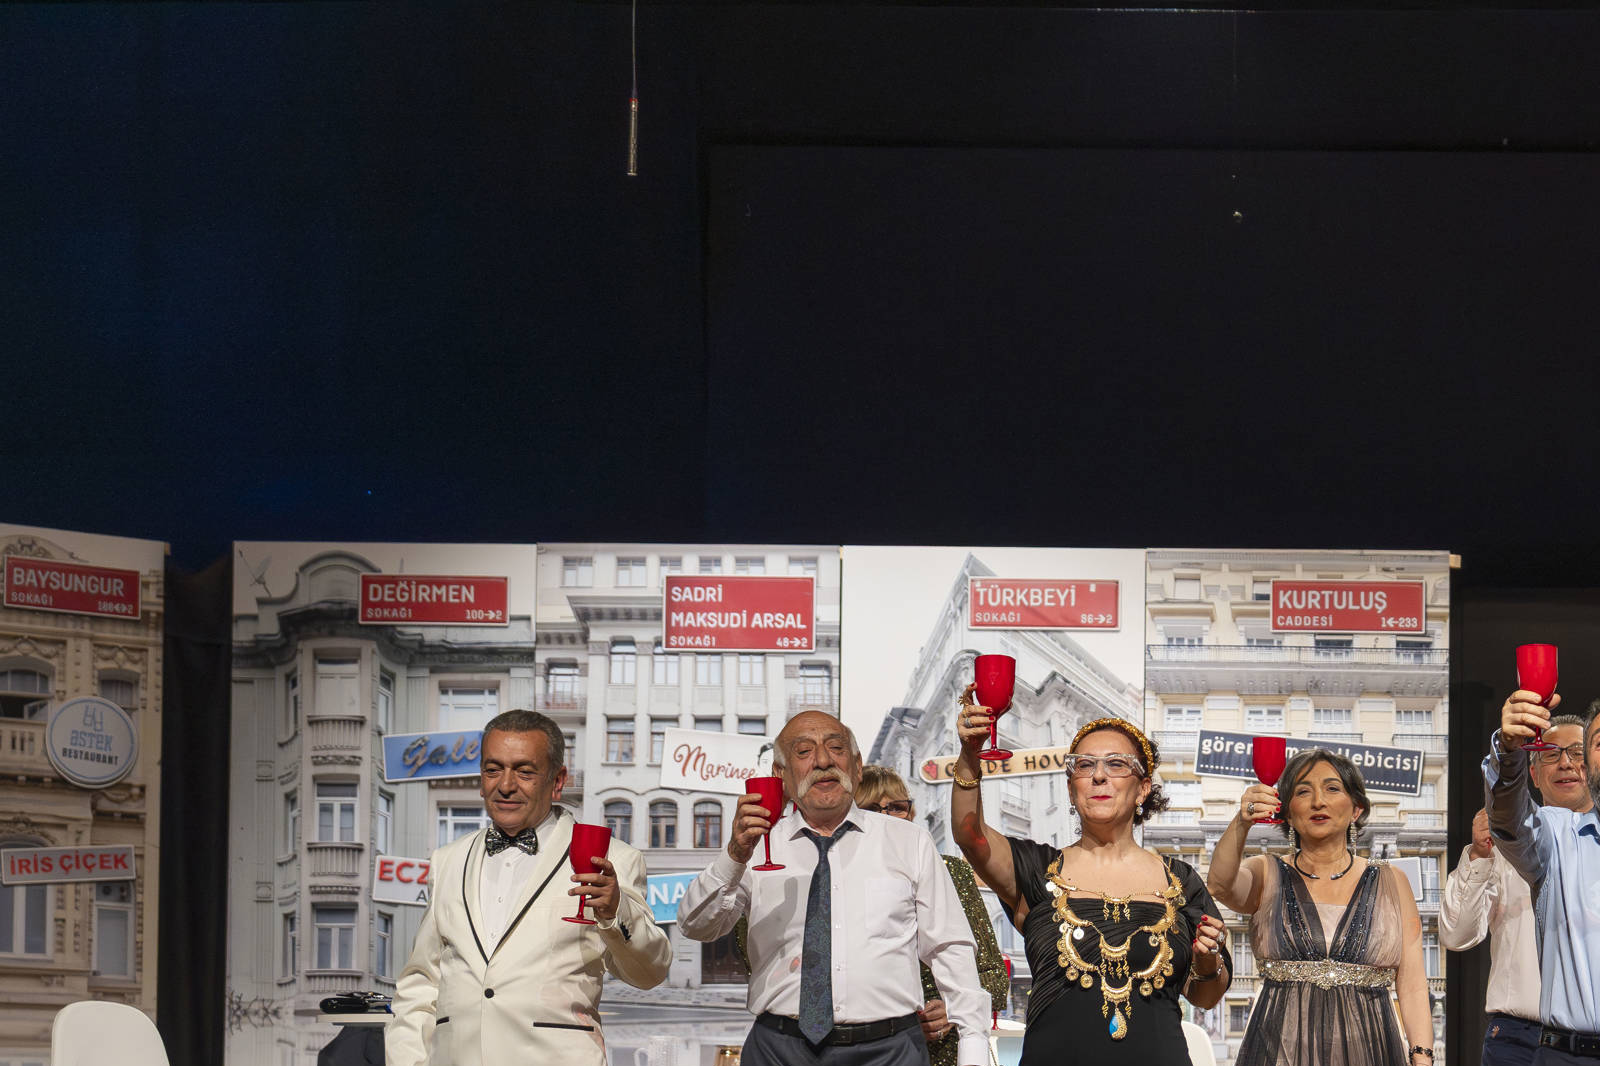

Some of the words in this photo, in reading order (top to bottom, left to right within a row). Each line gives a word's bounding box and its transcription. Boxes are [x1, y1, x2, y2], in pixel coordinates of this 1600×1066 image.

[13, 567, 124, 597] BAYSUNGUR
[368, 581, 475, 603] DEĞİRMEN
[671, 584, 723, 602] SADRİ
[976, 584, 1076, 606] TÜRKBEYİ
[1279, 590, 1387, 614] KURTULUŞ
[367, 607, 412, 619] SOKAĞI
[671, 610, 747, 629] MAKSUDİ
[751, 613, 807, 629] ARSAL
[975, 612, 1021, 623] SOKAĞI
[1277, 614, 1333, 627] CADDESİ
[669, 635, 716, 647] SOKAĞI
[62, 747, 119, 766] RESTAURANT
[402, 735, 481, 777] Gale
[673, 743, 756, 781] Marinee
[10, 852, 54, 876] İRİS
[59, 850, 129, 875] ÇİÇEK
[378, 859, 430, 885] ECZ
